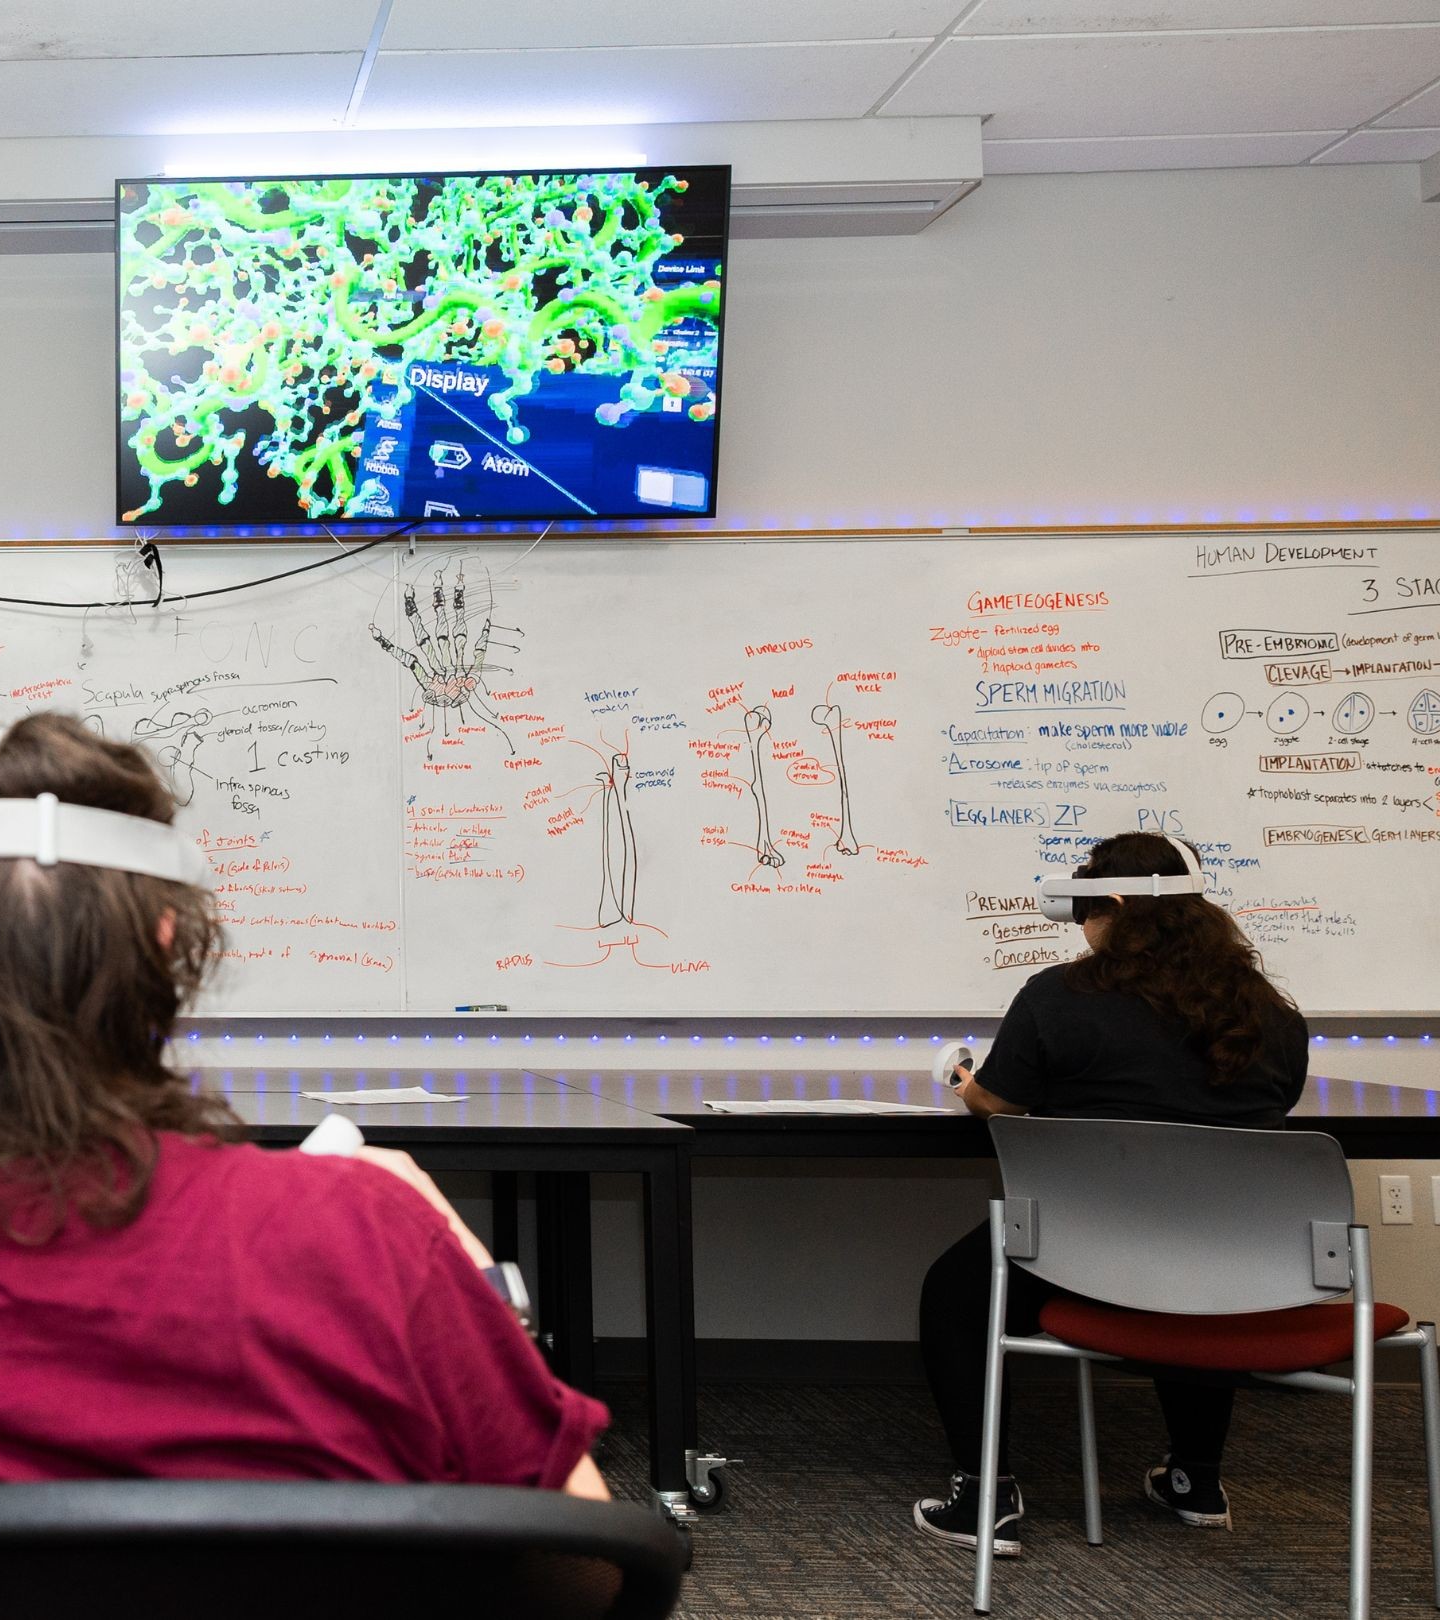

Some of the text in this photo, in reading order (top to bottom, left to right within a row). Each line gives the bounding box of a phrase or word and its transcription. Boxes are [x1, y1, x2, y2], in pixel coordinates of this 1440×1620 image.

[686, 265, 705, 274] Limit
[409, 366, 490, 398] Display
[483, 456, 530, 477] Atom
[1196, 542, 1378, 569] HUMAN DEVELOPMENT
[1362, 579, 1379, 602] 3
[1041, 623, 1060, 636] egg
[1007, 645, 1028, 655] stem
[1030, 644, 1044, 654] cell
[1414, 634, 1435, 646] germ
[981, 659, 1078, 676] 2 haploid gametes
[1267, 659, 1432, 684] CLEVAGE IMPLANTATION
[772, 684, 796, 698] head
[837, 670, 897, 693] anatomical neck
[82, 679, 144, 706] Scapula
[584, 688, 639, 703] trochlear
[976, 679, 1126, 707] SPERM MIGRATION
[242, 700, 298, 716] acromion
[1038, 722, 1073, 737] make
[1076, 723, 1116, 740] sperm
[1120, 724, 1148, 737] more
[1152, 722, 1189, 737] viable
[1273, 735, 1301, 747] zygote
[1209, 737, 1228, 748] egg
[247, 740, 266, 773] 1
[1265, 756, 1356, 771] IMPLANTATION
[1034, 757, 1052, 775] tip
[1056, 759, 1071, 772] of
[1075, 763, 1109, 777] sperm
[1314, 791, 1357, 804] separates
[1382, 794, 1388, 806] 2
[1393, 795, 1421, 813] layers
[955, 805, 1046, 825] EGG LAYERS
[1054, 804, 1088, 826] ZP
[1138, 808, 1184, 833] PVS
[1372, 828, 1401, 843] GERM
[1228, 858, 1261, 873] sperm
[964, 890, 1039, 913] PRENATAL
